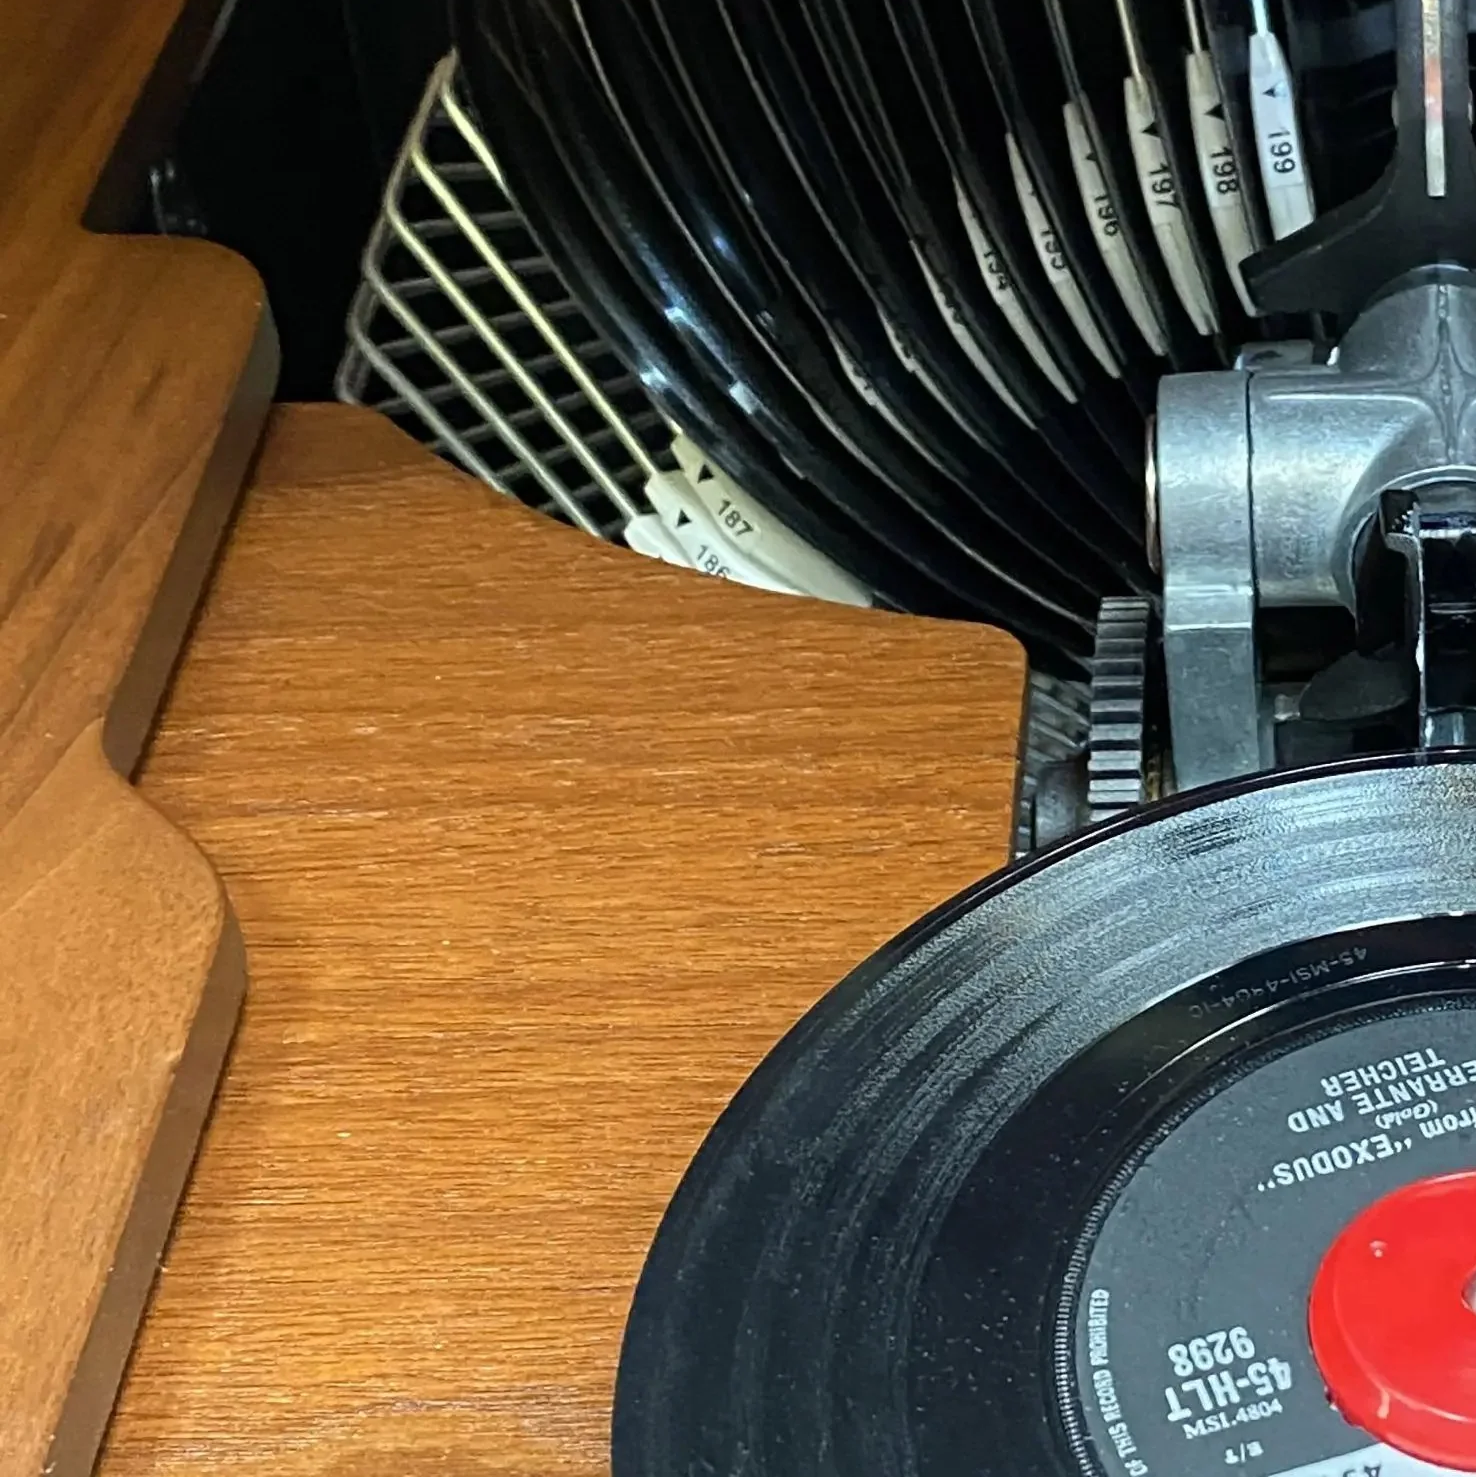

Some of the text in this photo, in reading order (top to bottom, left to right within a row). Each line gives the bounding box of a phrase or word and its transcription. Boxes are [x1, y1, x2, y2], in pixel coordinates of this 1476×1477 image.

[1210, 146, 1238, 194] 198
[1268, 127, 1296, 173] 199
[1149, 162, 1181, 208] 197
[718, 500, 754, 536] 187
[697, 545, 730, 579] 186
[1320, 1047, 1446, 1097] TEICHER
[1286, 1099, 1345, 1133] AND
[1257, 1133, 1413, 1192] “EXODUS”
[1168, 1326, 1255, 1377] 9298
[1087, 1288, 1148, 1477] OF THIS RECORD PROHIBITED
[1164, 1357, 1292, 1422] 45-HLT
